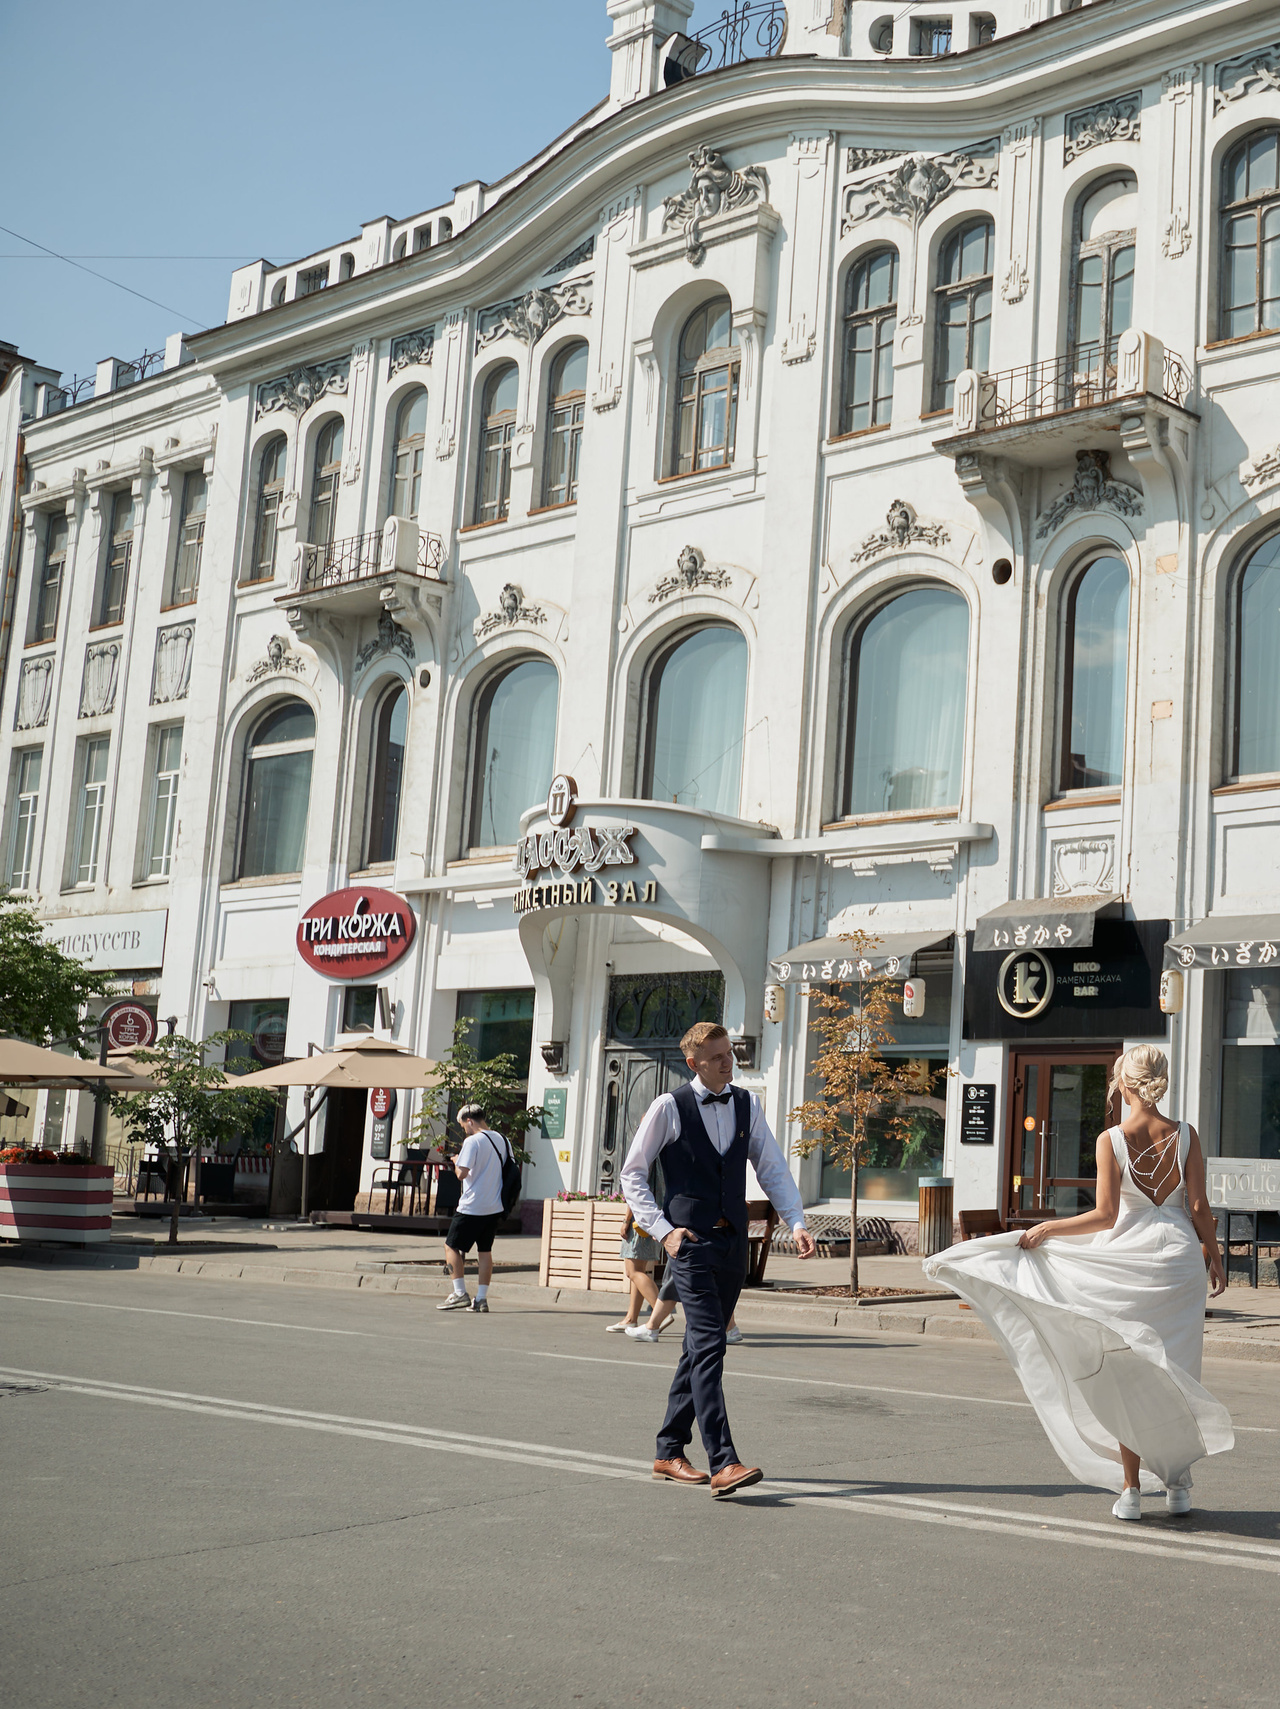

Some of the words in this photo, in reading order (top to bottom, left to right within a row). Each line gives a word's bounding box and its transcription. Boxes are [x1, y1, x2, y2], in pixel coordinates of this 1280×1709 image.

[512, 876, 593, 913] АНКЕТНЫЙ
[607, 880, 657, 903] ЗАЛ
[299, 916, 334, 942] ТРИ
[338, 905, 401, 939] КОРЖА
[993, 923, 1073, 947] いざかや
[61, 930, 141, 959] ИСКУССТВ
[313, 941, 382, 957] КОНДИТЕРСКАЯ
[802, 958, 873, 980] いざかや
[1073, 962, 1100, 972] KIKO
[1056, 976, 1085, 984] RAMEN
[1086, 974, 1122, 983] IZAKAYA
[1073, 986, 1098, 996] BAR
[1254, 1162, 1273, 1173] THE
[1253, 1195, 1271, 1205] BAR
